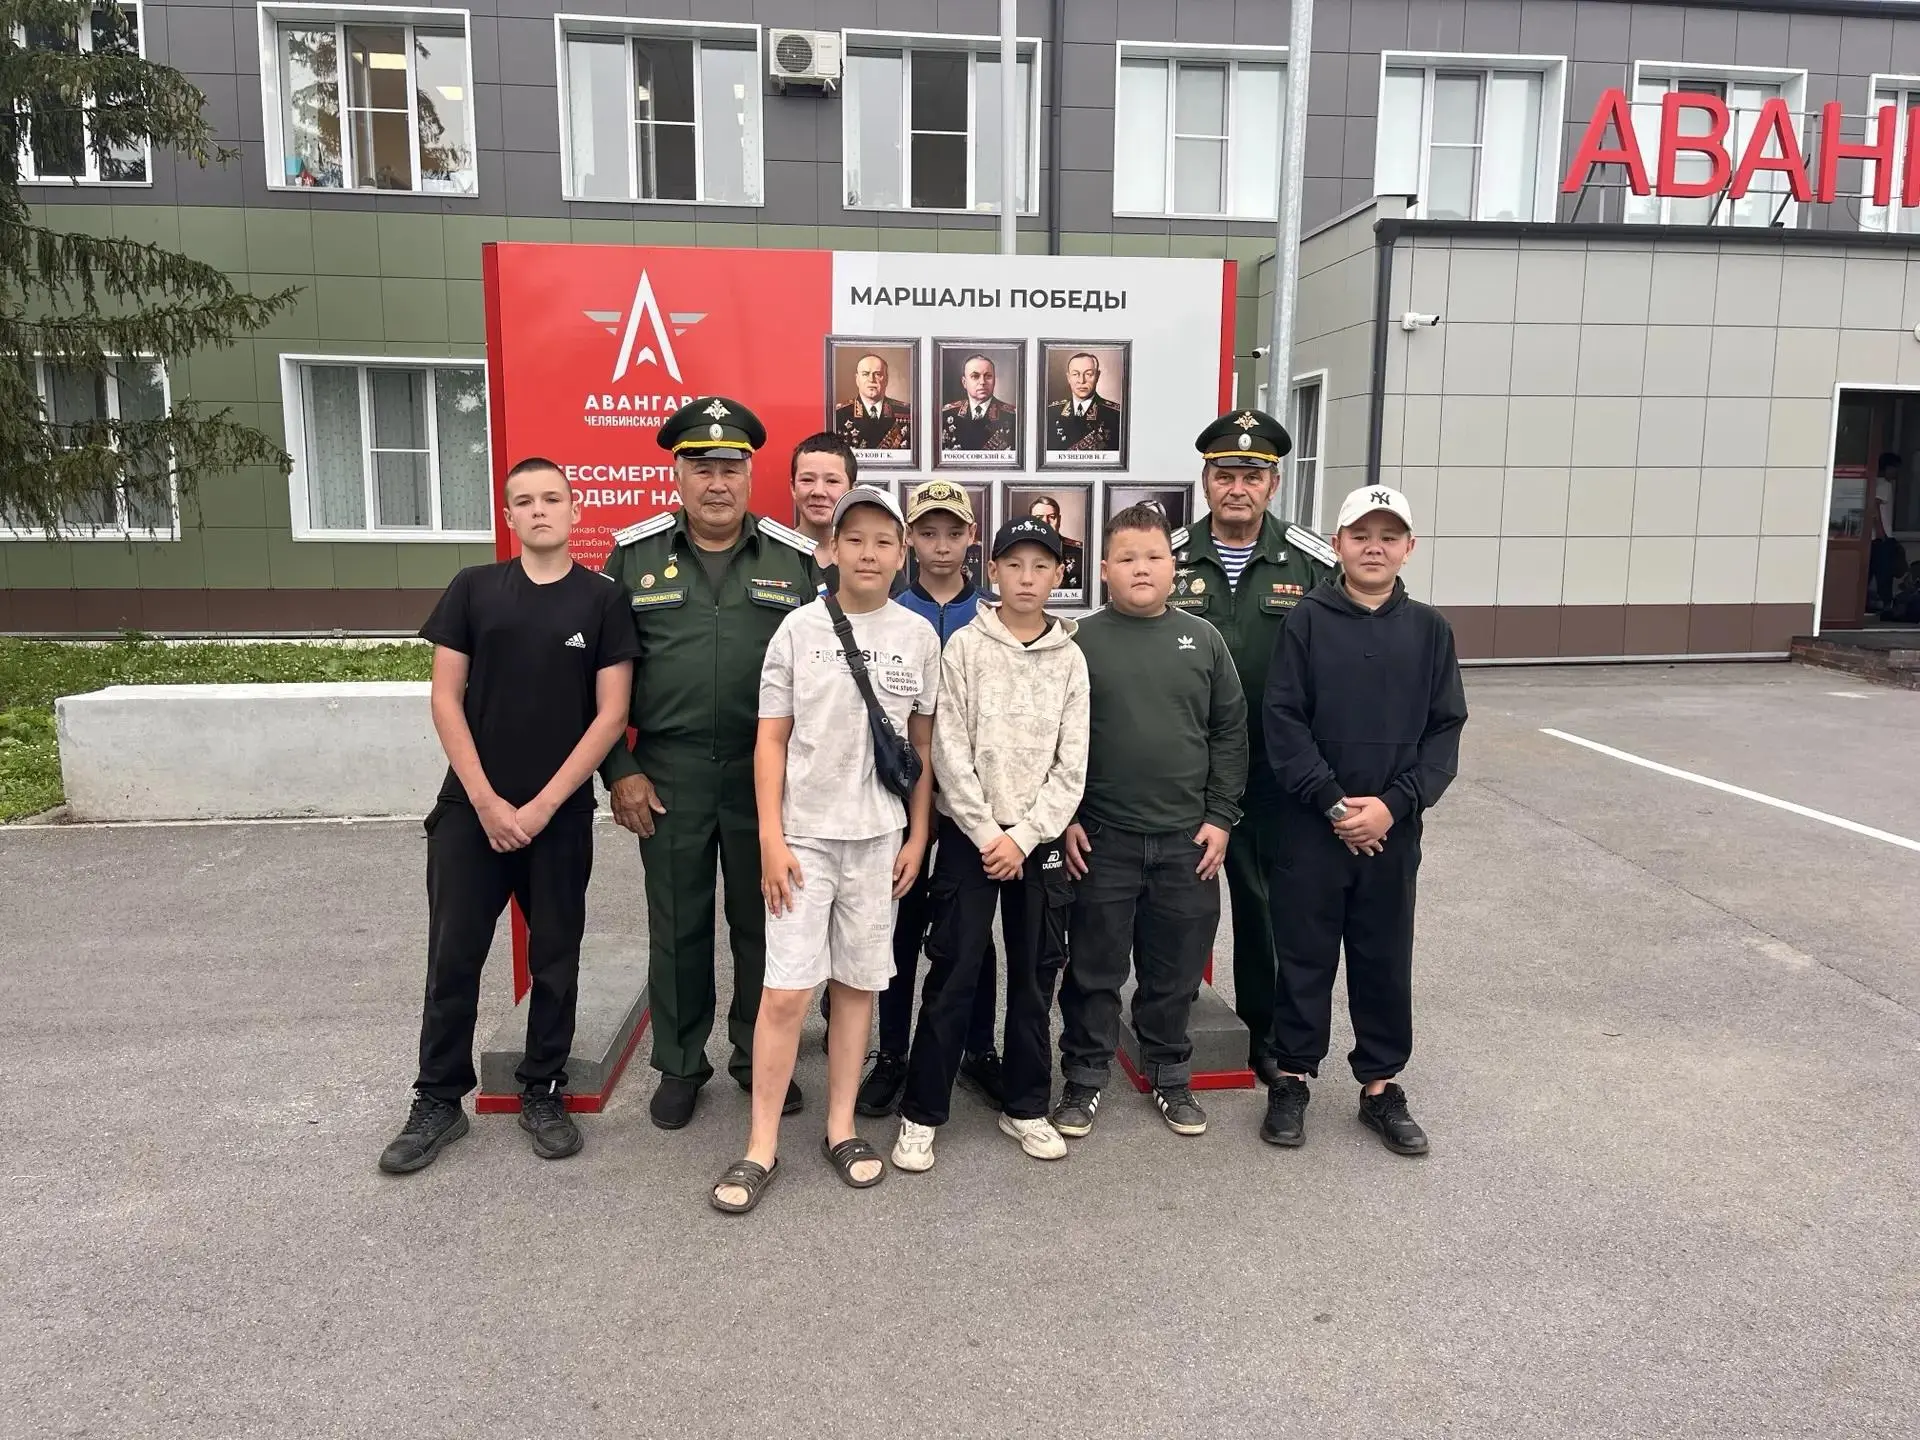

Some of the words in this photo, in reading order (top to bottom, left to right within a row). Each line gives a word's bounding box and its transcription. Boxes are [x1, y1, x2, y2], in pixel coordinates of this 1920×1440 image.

[850, 286, 1001, 308] МАРШАЛЫ
[1010, 288, 1127, 312] ПОБЕДЫ
[584, 394, 709, 411] АВАНГАР
[584, 415, 661, 428] ЧЕЛЯБИНСКАЯ
[558, 465, 674, 482] ЕССМЕРТ
[571, 489, 645, 507] ОДВИГ
